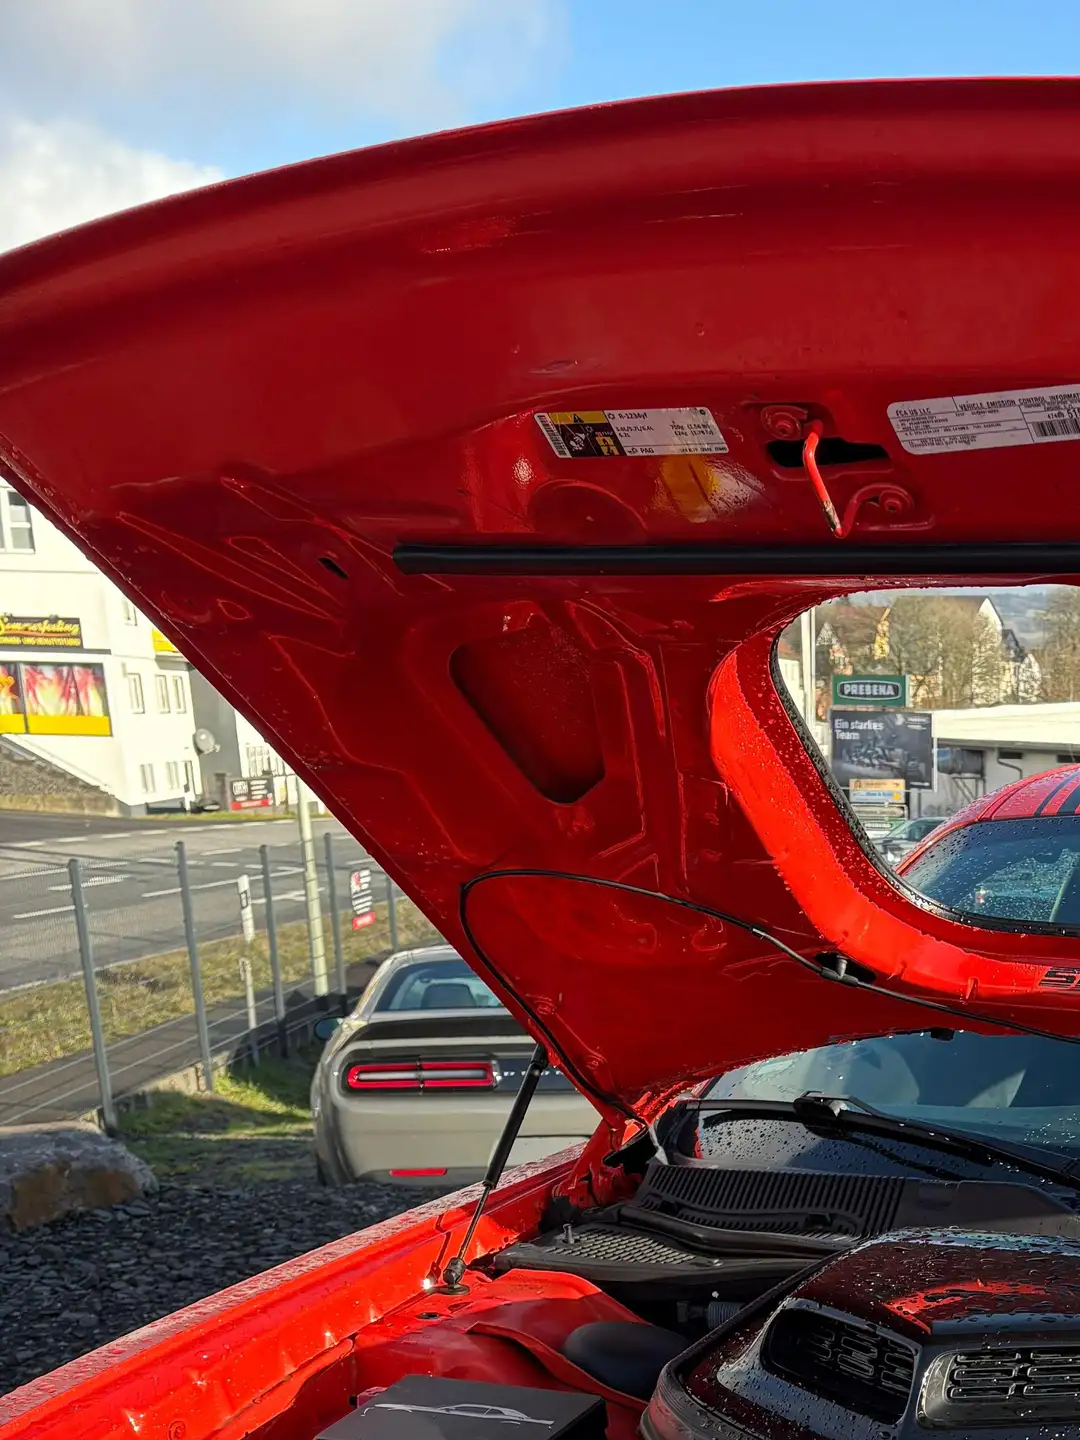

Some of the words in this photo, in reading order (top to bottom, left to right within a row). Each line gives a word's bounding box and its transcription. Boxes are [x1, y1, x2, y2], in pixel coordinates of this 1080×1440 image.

[959, 400, 985, 411] VEHICLE
[987, 398, 1016, 409] EMISSION
[1018, 395, 1045, 405] CONTROL
[895, 408, 908, 417] FCA
[919, 407, 932, 415] LLC
[843, 683, 895, 696] PREBENA
[850, 719, 885, 731] starkes
[835, 729, 861, 740] Team
